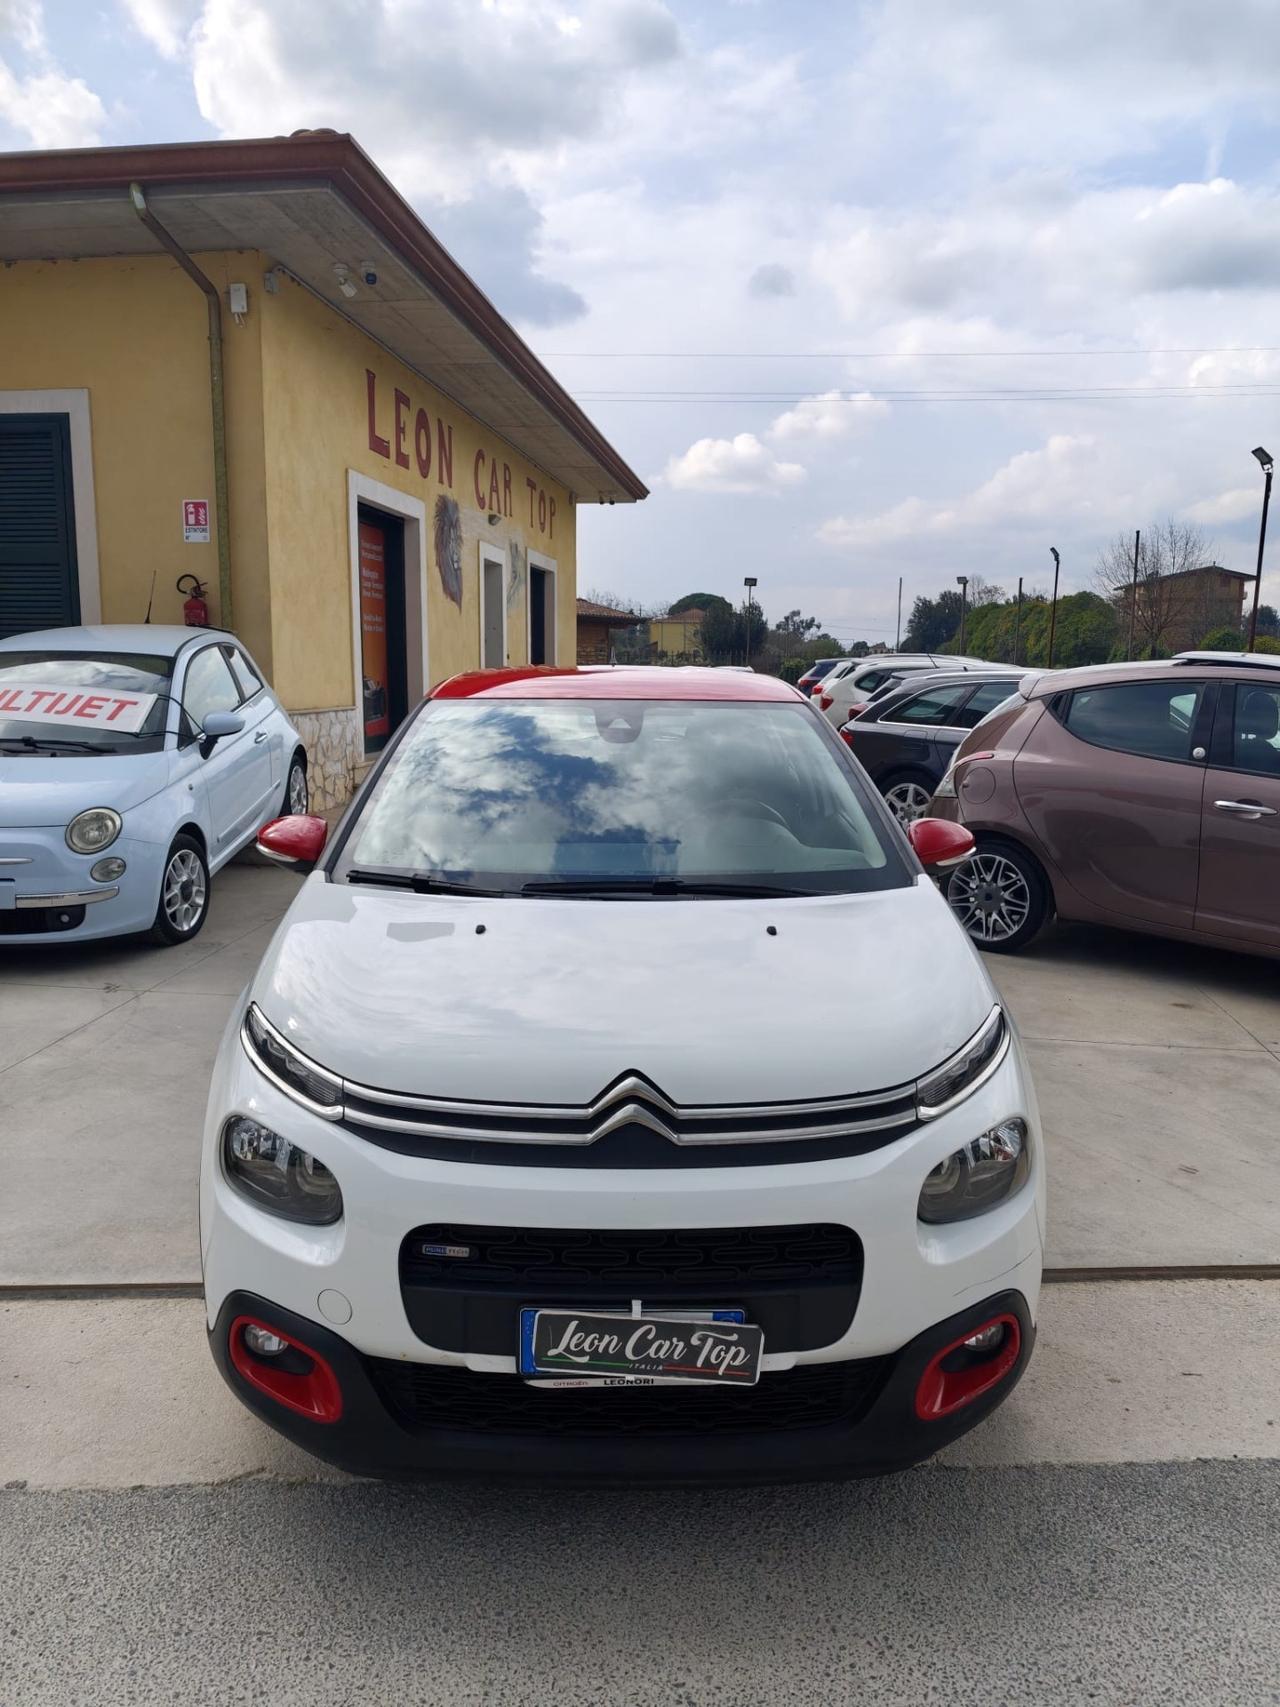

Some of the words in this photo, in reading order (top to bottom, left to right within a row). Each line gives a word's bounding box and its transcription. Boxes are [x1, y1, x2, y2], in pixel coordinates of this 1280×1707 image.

[366, 368, 453, 488] LEON
[474, 448, 512, 518] CAR
[526, 477, 556, 539] TOP
[547, 1320, 622, 1363] Leon
[625, 1324, 687, 1361] Car
[690, 1331, 750, 1376] Top
[604, 1378, 654, 1386] LEONORI
[628, 1363, 664, 1372] ITALIA
